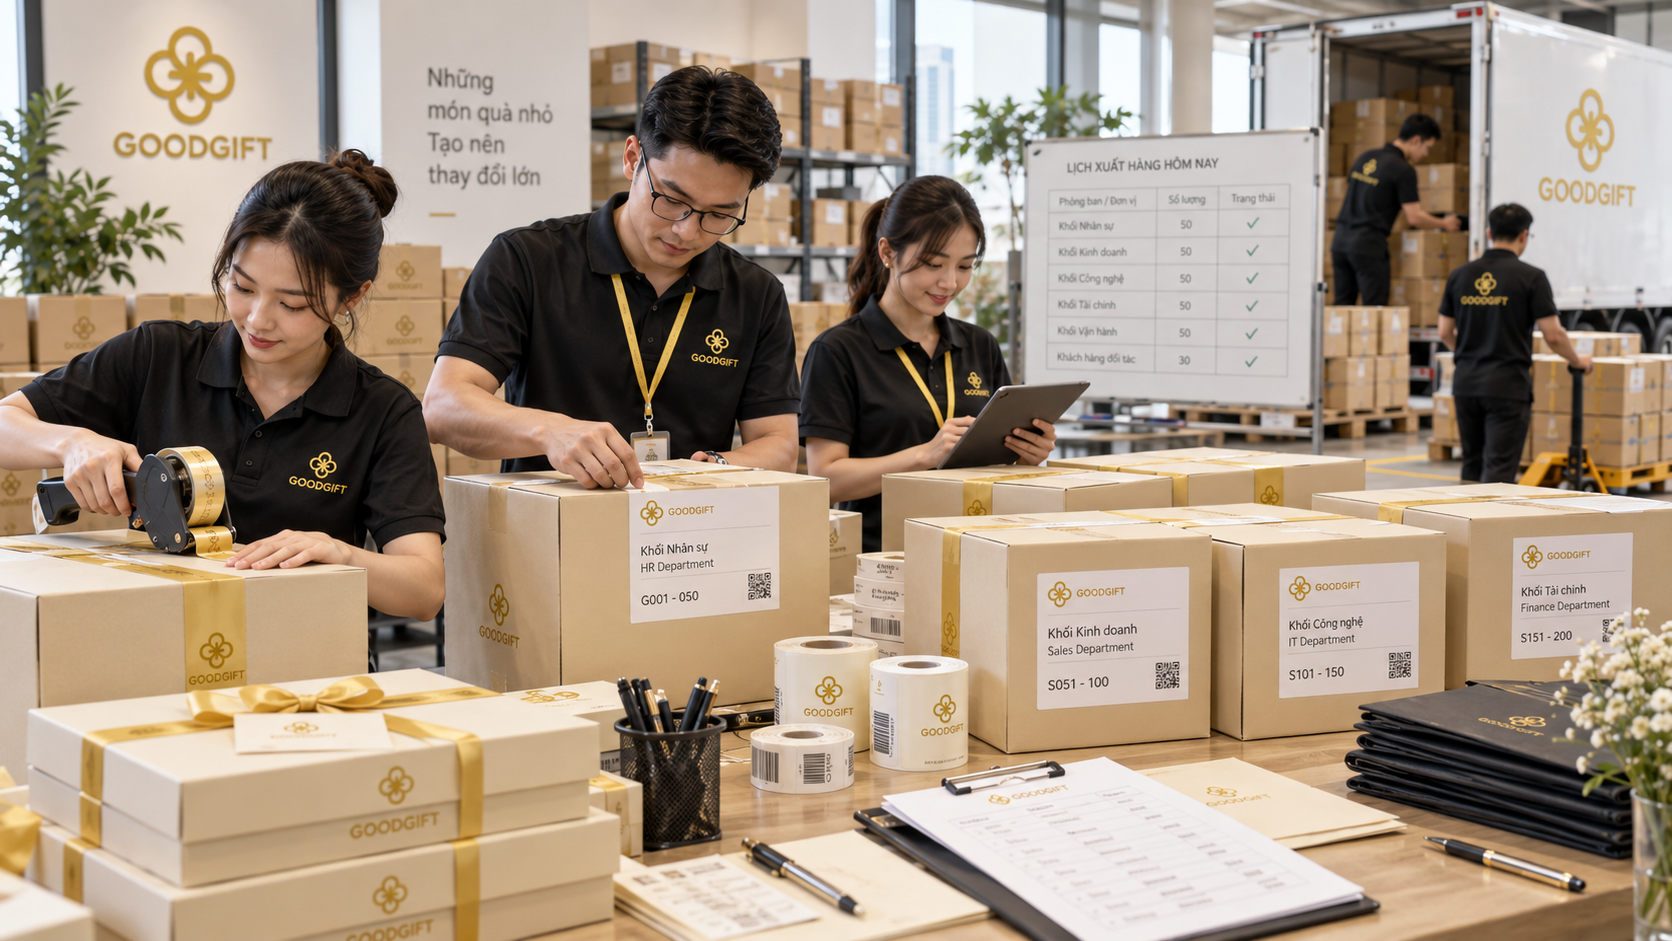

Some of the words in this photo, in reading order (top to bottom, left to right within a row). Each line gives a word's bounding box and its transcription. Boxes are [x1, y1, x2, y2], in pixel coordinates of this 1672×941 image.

[427, 67, 494, 96] Những
[428, 100, 471, 120] món
[477, 102, 512, 126] quà
[518, 103, 554, 124] nhỏ
[113, 131, 273, 162] GOODGIFT
[427, 132, 463, 157] Tạo
[470, 133, 505, 154] nên
[1067, 162, 1092, 176] LỊCH
[1095, 157, 1125, 172] XUẤT
[1128, 158, 1161, 171] HÀNG
[1164, 156, 1192, 170] HÔM
[1195, 157, 1219, 169] NAY
[428, 164, 471, 190] thay
[477, 163, 506, 186] đổi
[512, 165, 541, 186] lớn
[1168, 193, 1180, 205] Số
[1538, 176, 1637, 208] GOODGIFT
[1087, 196, 1103, 206] ban
[1104, 222, 1115, 232] sự
[1180, 219, 1193, 230] 50
[1079, 247, 1098, 257] Kinh
[1100, 246, 1128, 257] doanh
[1180, 246, 1192, 257] 50
[1179, 273, 1192, 284] 50
[1179, 300, 1191, 311] 50
[1461, 294, 1509, 307] GOODGIFT
[1179, 327, 1191, 338] 50
[691, 352, 740, 369] GOODGIFT
[1178, 355, 1190, 366] 30
[288, 475, 348, 496] GOODGIFT
[668, 505, 715, 516] GOODGIFT
[640, 543, 664, 557] Khối
[696, 543, 709, 555] sự
[1546, 550, 1592, 560] GOODGIFT
[641, 562, 655, 573] HR
[657, 558, 715, 573] Department
[1076, 586, 1126, 598] GOODGIFT
[1315, 581, 1361, 592] GOODGIFT
[1521, 585, 1543, 597] Khối
[1545, 585, 1559, 596] Tài
[641, 593, 668, 606] G001
[679, 590, 699, 603] 050
[1520, 602, 1555, 613] Finance
[1557, 599, 1610, 613] Department
[1289, 618, 1311, 631] Khối
[1313, 618, 1338, 631] Công
[1340, 616, 1364, 629] nghệ
[479, 625, 520, 649] GOODGIFT
[1048, 625, 1073, 640] Khối
[1076, 625, 1101, 638] Kinh
[1103, 623, 1138, 637] doanh
[1520, 632, 1544, 644] S151
[1553, 630, 1573, 642] 200
[1288, 637, 1298, 648] IT
[1300, 634, 1355, 648] Department
[1048, 645, 1073, 657] Sales
[1076, 641, 1135, 656] Department
[188, 668, 246, 687] GOODGIFT
[1289, 669, 1315, 681] S101
[1325, 666, 1345, 678] 150
[1048, 677, 1076, 691] S051
[1088, 676, 1110, 689] 100
[803, 707, 854, 718] GOODGIFT
[920, 723, 964, 738] GOODGIFT
[1011, 784, 1069, 801] GOODGIFT
[349, 812, 440, 840] GOODGIFT
